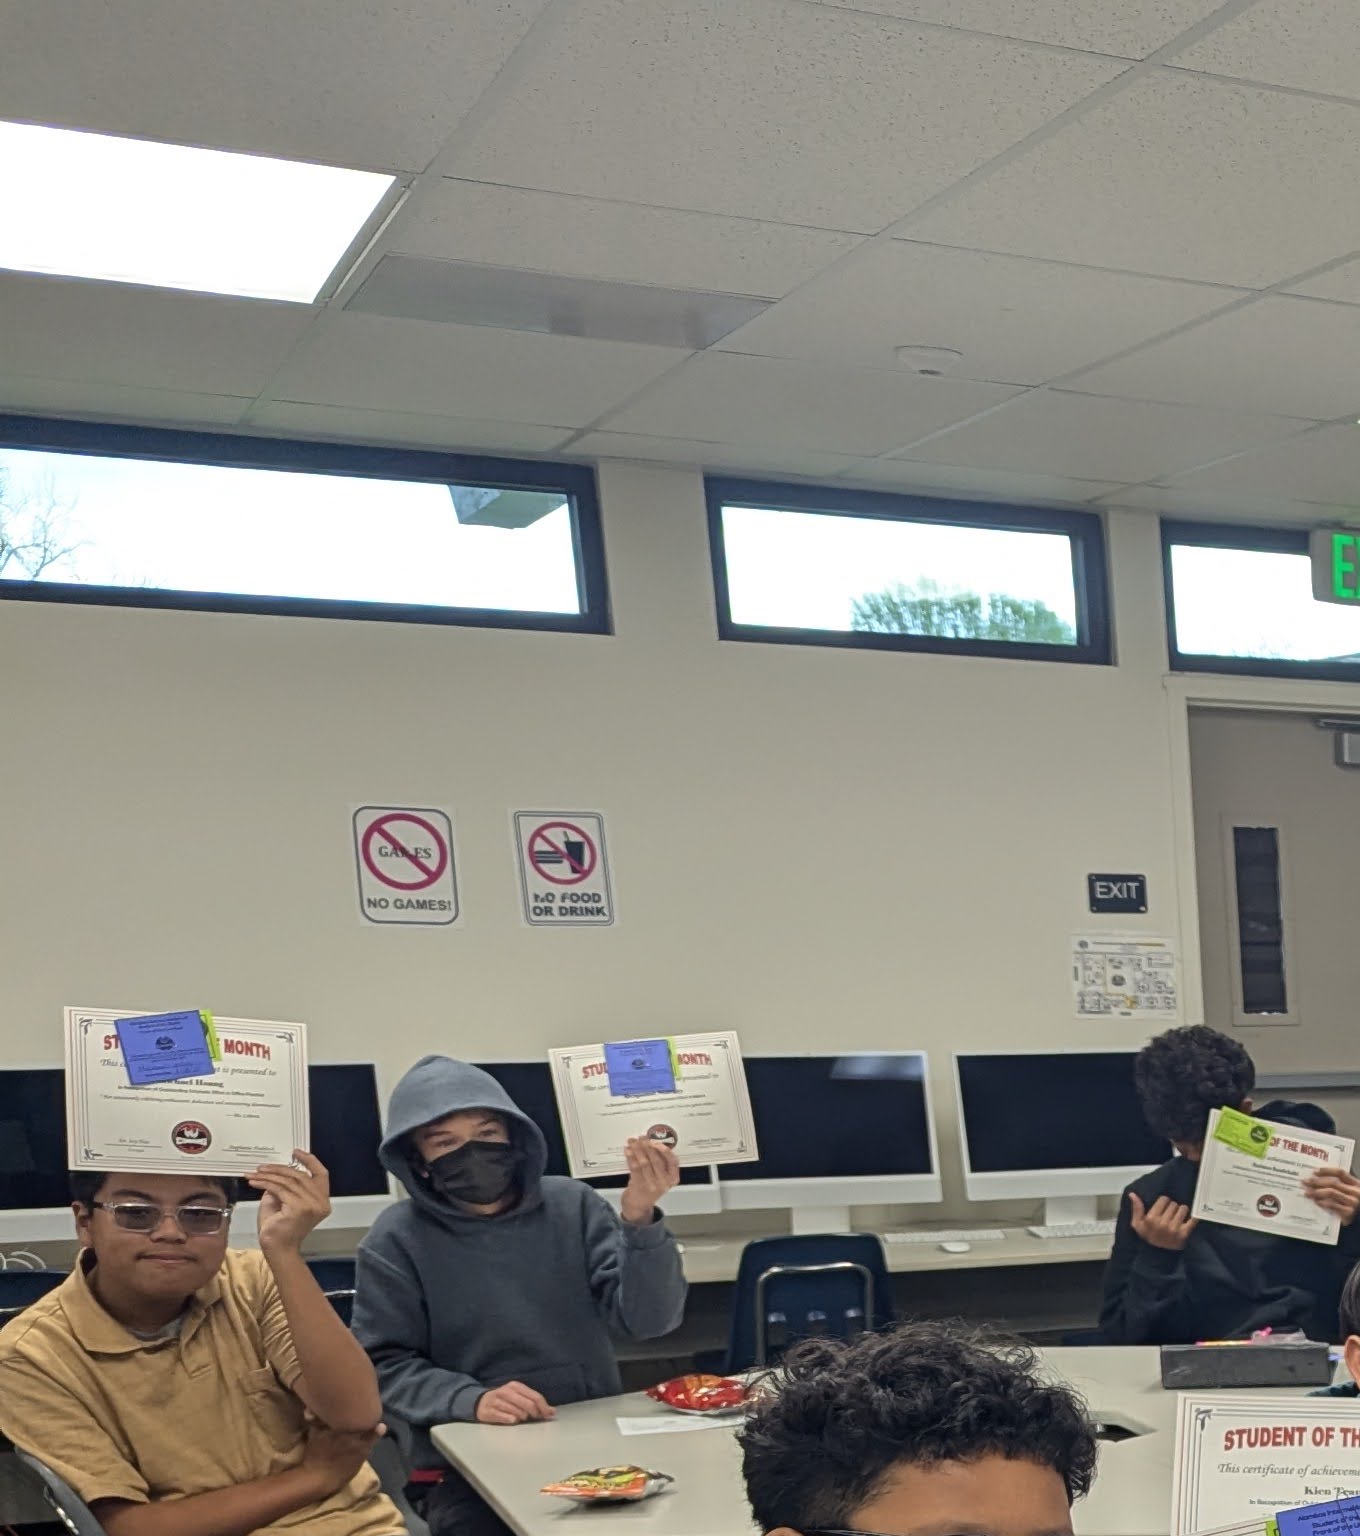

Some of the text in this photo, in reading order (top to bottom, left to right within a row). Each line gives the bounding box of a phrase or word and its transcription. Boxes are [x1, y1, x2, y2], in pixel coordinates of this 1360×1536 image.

[1095, 881, 1140, 899] EXIT
[367, 898, 452, 912] NO GAMES!
[561, 893, 602, 904] FOOD
[533, 906, 607, 918] OR DRINK
[224, 1038, 271, 1061] MONTH
[1283, 1139, 1300, 1152] THE
[1301, 1143, 1330, 1162] MONTH
[1224, 1426, 1307, 1451] STUDENT
[1312, 1426, 1335, 1447] OF
[1218, 1463, 1240, 1473] This
[1242, 1464, 1296, 1477] certificate
[1297, 1464, 1310, 1478] of
